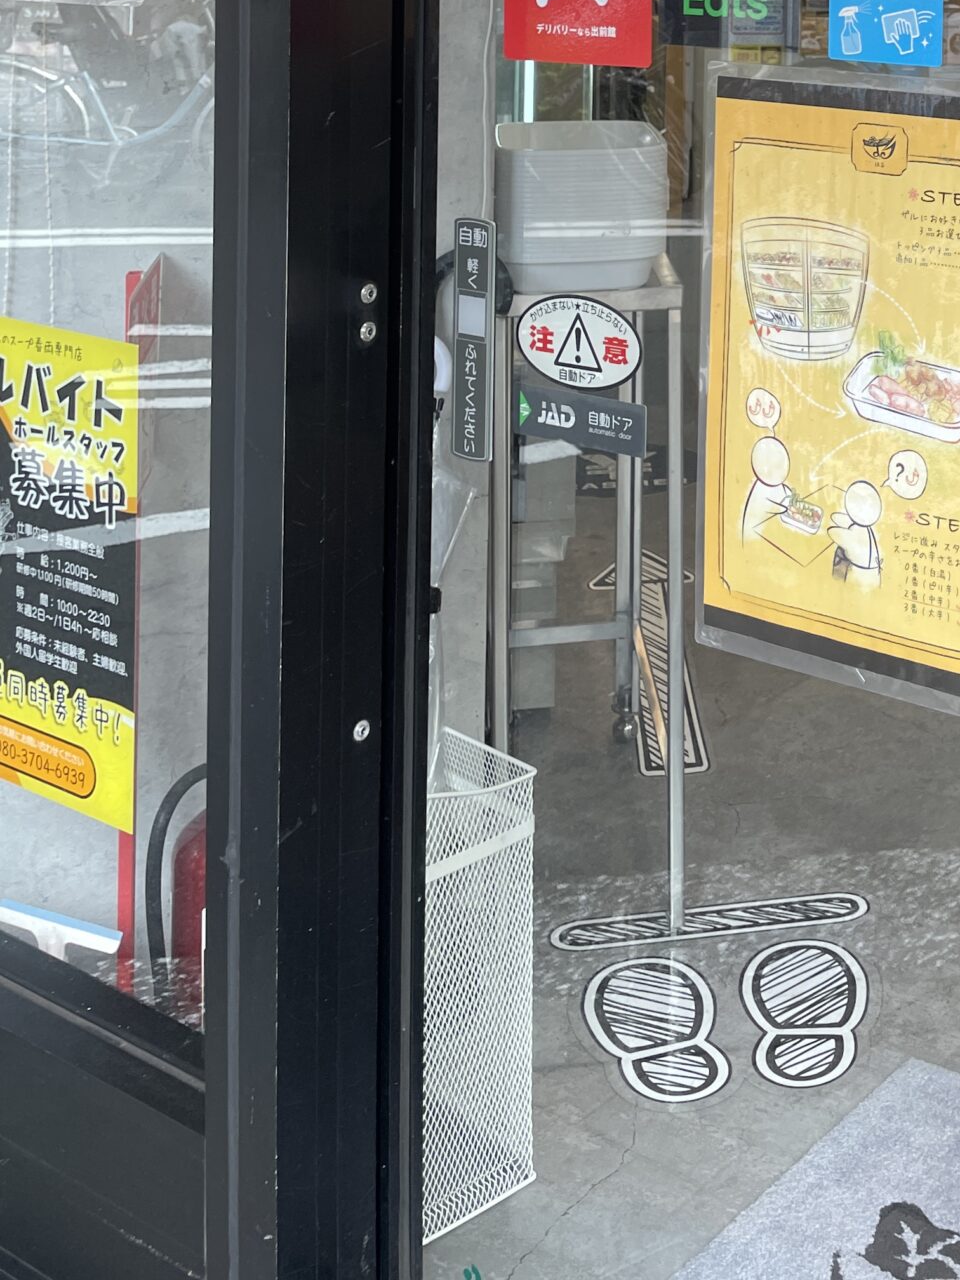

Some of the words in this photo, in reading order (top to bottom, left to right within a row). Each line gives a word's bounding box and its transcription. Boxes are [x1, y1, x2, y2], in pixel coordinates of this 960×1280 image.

[536, 23, 617, 39] デリバリーなら出前館
[458, 225, 488, 248] 自動
[466, 257, 479, 289] 軽く
[0, 336, 83, 362] のスープ春雨専門店
[529, 324, 555, 354] 注
[602, 336, 629, 366] 意
[558, 368, 597, 384] 自動ドア
[463, 344, 478, 453] ふれてください
[588, 410, 633, 431] 自動ドア
[588, 427, 616, 438] automatic
[618, 431, 632, 440] door
[14, 417, 126, 464] ホールスタッフ
[11, 448, 128, 526] 募集中
[0, 672, 122, 743] 同時募集中！
[0, 740, 86, 789] 80-3704-6939
